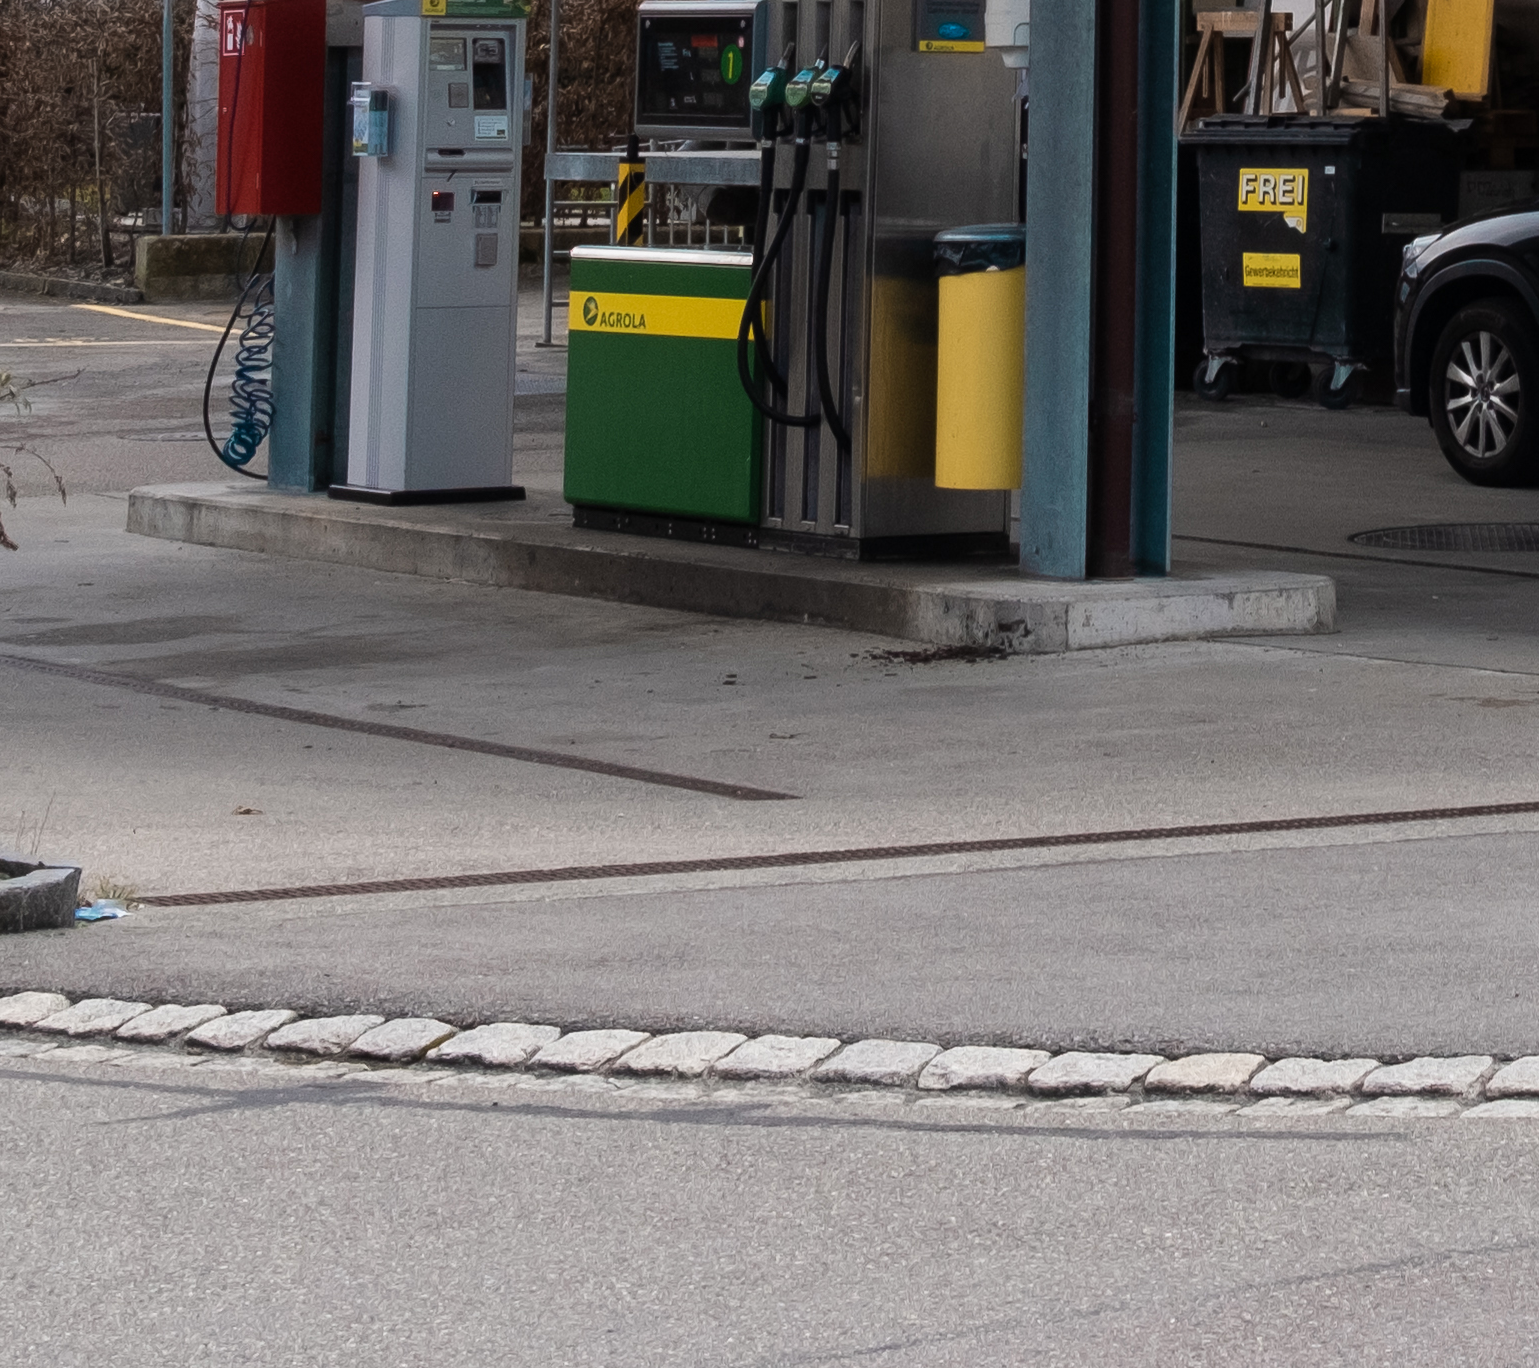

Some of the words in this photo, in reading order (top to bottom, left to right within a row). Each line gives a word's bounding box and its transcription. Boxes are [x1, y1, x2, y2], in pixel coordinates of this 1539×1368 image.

[727, 51, 734, 80] 1
[1241, 173, 1305, 206] FREI
[600, 312, 647, 329] AGROLA
